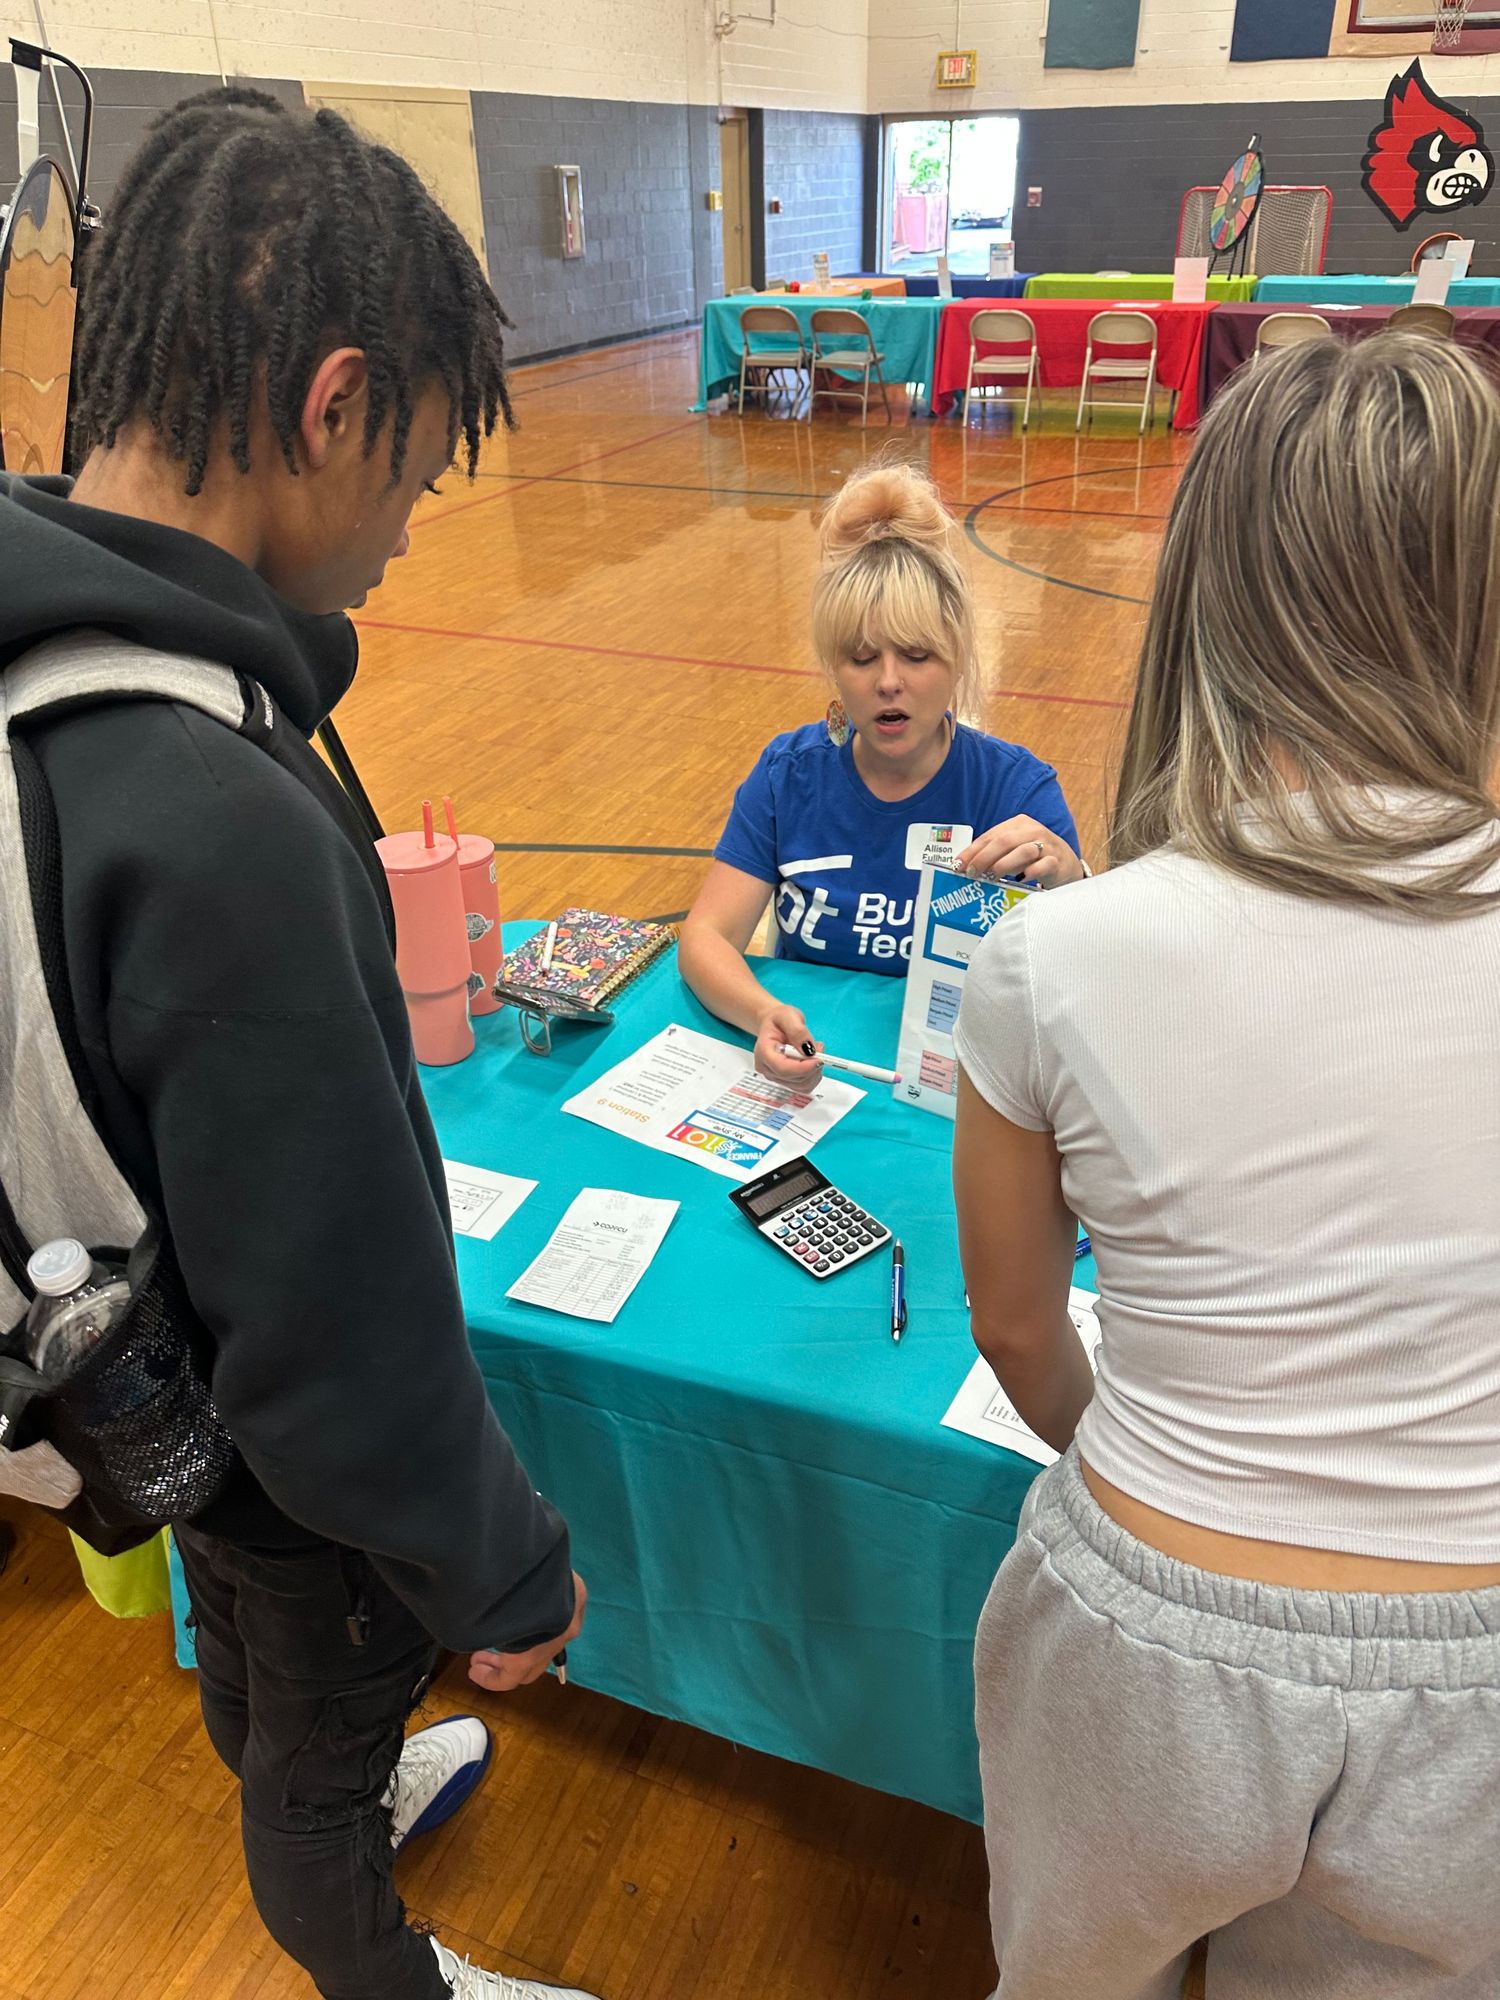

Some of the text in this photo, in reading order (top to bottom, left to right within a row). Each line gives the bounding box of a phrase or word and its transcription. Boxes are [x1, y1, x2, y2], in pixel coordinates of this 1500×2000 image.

[922, 853, 954, 863] Fullhart
[923, 844, 953, 853] Allison
[855, 893, 918, 926] Bu
[930, 881, 986, 918] FINANCES
[608, 1101, 650, 1123] Station
[671, 1125, 763, 1161] FINANCES 101
